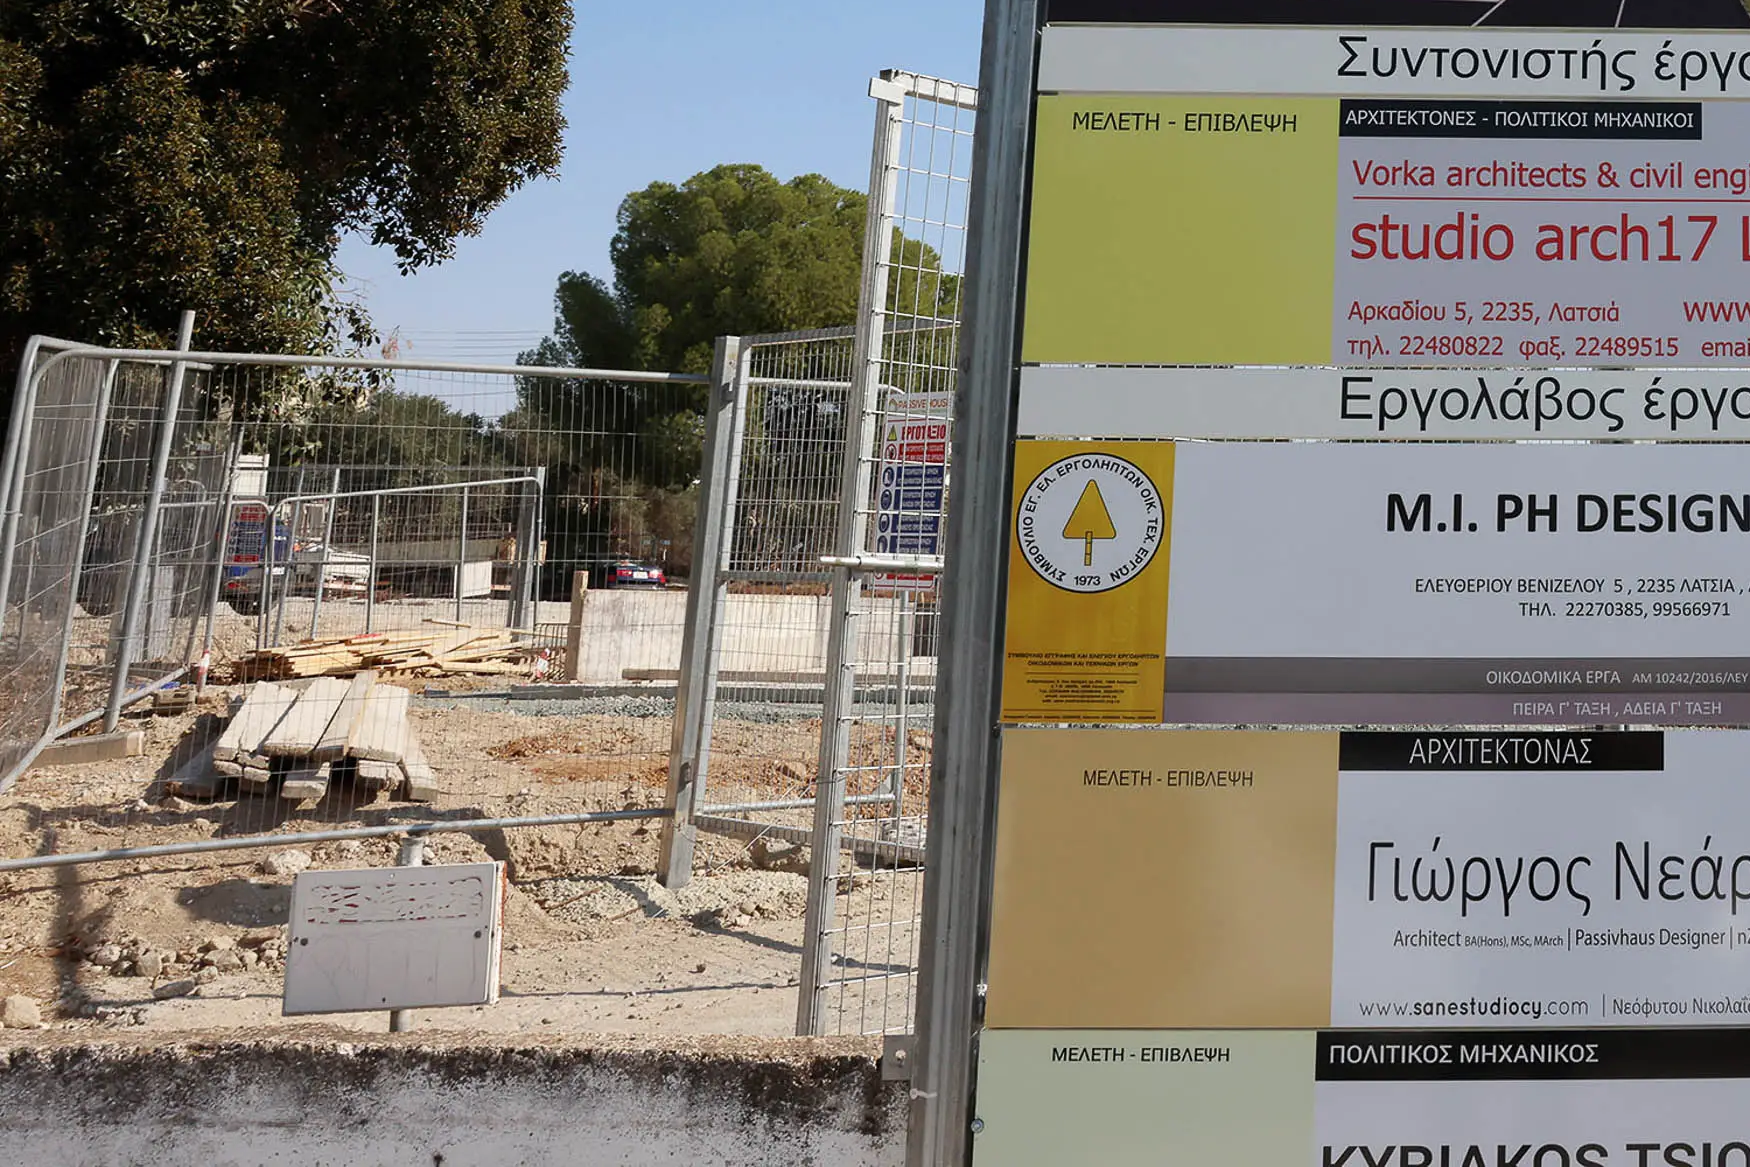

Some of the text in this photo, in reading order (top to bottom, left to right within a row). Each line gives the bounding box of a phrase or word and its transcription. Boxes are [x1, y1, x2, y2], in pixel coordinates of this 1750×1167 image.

[1337, 35, 1637, 92] Συντονιστής
[1072, 111, 1161, 134] ΜΕΛΕΤΗ
[1183, 111, 1297, 136] ΕΠΙΒΛΕΨΗ
[1344, 109, 1477, 127] ΑΡΧΙΤΕΚΤΟΝΕΣ
[1494, 110, 1589, 128] ΠΟΛΙΤΙΚΟΙ
[1594, 111, 1694, 129] ΜΗΧΑΝΙΚΟΙ
[1352, 159, 1435, 187] Vorka
[1446, 159, 1588, 189] architects
[1596, 161, 1621, 189] &
[1629, 160, 1685, 189] civil
[1350, 211, 1515, 262] studio
[1535, 212, 1718, 262] arch17
[1347, 298, 1620, 326] Αρκαδίου 5, 2235, Λατσιά
[1346, 334, 1679, 362] τηλ. 22480822 φαξ. 22489515
[1340, 376, 1625, 433] Εργολάβος
[1022, 516, 1066, 582] ΣΥΜΒΟΥΛΙΟ
[1056, 458, 1144, 489] ΕΡΓΟΛΗΠΤΩΝ
[1109, 546, 1149, 582] ΕΡΓΩΝ
[1386, 492, 1478, 533] M.I.
[1496, 493, 1558, 533] PH
[1576, 493, 1750, 534] DESIGN
[1073, 575, 1101, 586] 1973
[1415, 578, 1513, 594] ΕΛΕΥΘΕΡΙΟΥ
[1517, 578, 1606, 594] ΒΕΝΙΖΕΛΟΥ
[1636, 578, 1676, 594] 2235
[1518, 599, 1731, 620] ΤΗΛ. 22270385, 99566971
[1485, 667, 1749, 686] ΟΙΚΟΔΟΜΙΚΑ ΕΡΓΑ ΑΜ 10242/2016/ΛΕΥ
[1408, 737, 1593, 765] ΑΡΧΙΤΕΚΤΟΝΑΣ
[1083, 767, 1153, 789] ΜΕΛΕΤΗ
[1167, 767, 1254, 788] ΕΠΙΒΛΕΨΗ
[1368, 835, 1592, 918] Γιώργος
[1393, 928, 1462, 948] Architect
[1464, 934, 1509, 950] BA(Hons),
[1510, 934, 1533, 949] MSc,
[1533, 934, 1564, 947] MArch
[1575, 927, 1656, 947] Passivhaus
[1659, 927, 1726, 950] Designer
[1359, 996, 1592, 1020] www.sanestudiocy.com
[1612, 996, 1688, 1019] Νεόφυτου
[1051, 1046, 1125, 1065] ΜΕΛΕΤΗ
[1140, 1047, 1231, 1063] ΕΠΙΒΛΕΨΗ
[1329, 1043, 1600, 1065] ΠΟΛΙΤΙΚΟΣ ΜΗΧΑΝΙΚΟΣ
